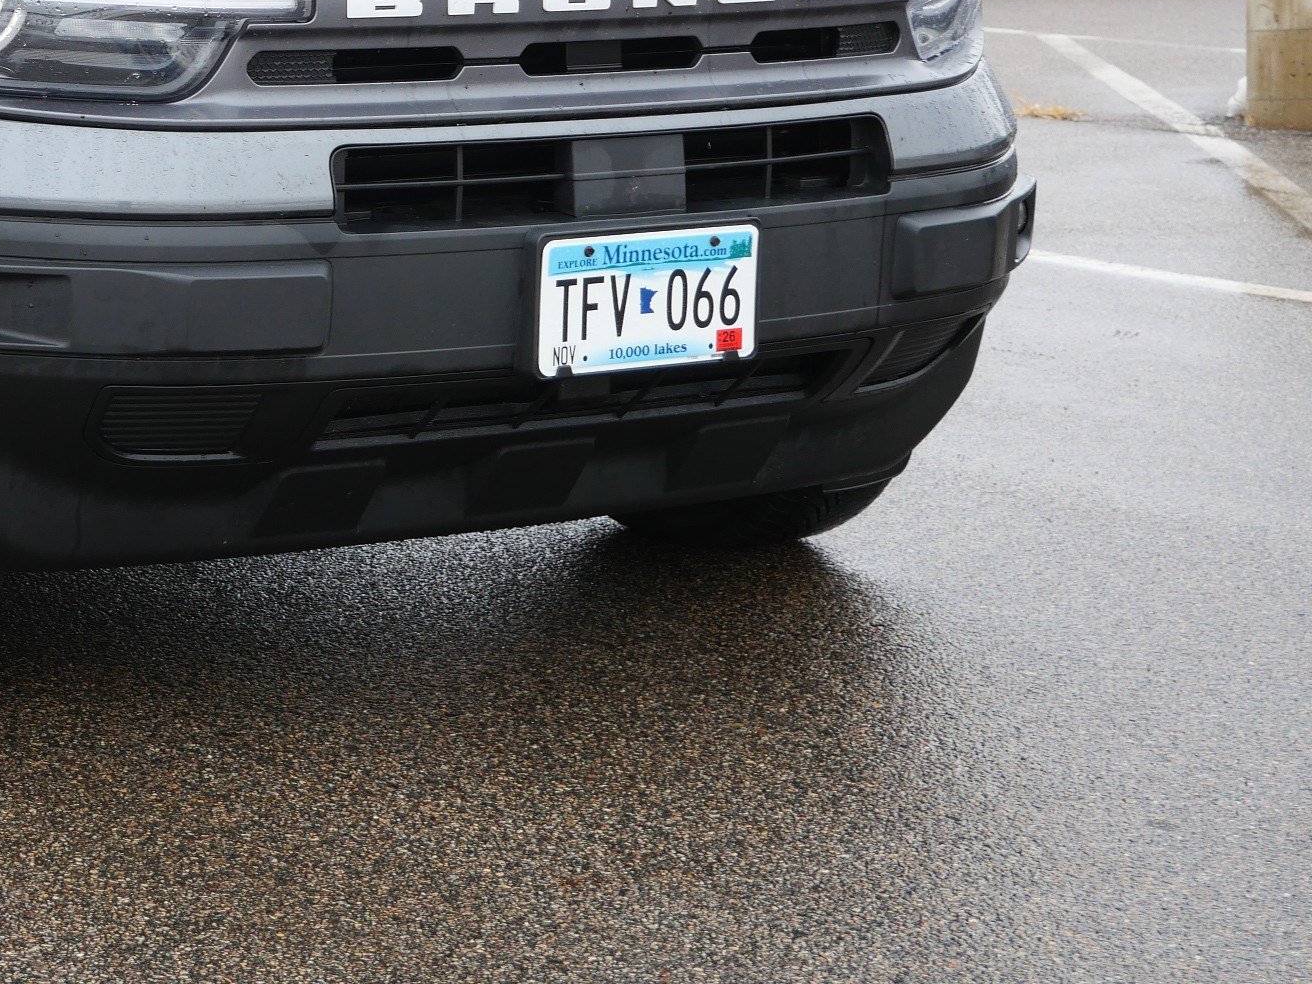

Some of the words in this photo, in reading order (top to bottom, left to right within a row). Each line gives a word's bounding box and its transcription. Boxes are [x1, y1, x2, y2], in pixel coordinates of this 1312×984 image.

[558, 257, 598, 270] EXPLORE
[601, 243, 728, 266] Minnesota.com
[555, 273, 632, 343] TFV
[665, 264, 741, 331] 066
[722, 330, 736, 343] 26
[552, 344, 577, 366] NOV
[608, 344, 650, 360] 10,000
[654, 342, 688, 356] lakes
